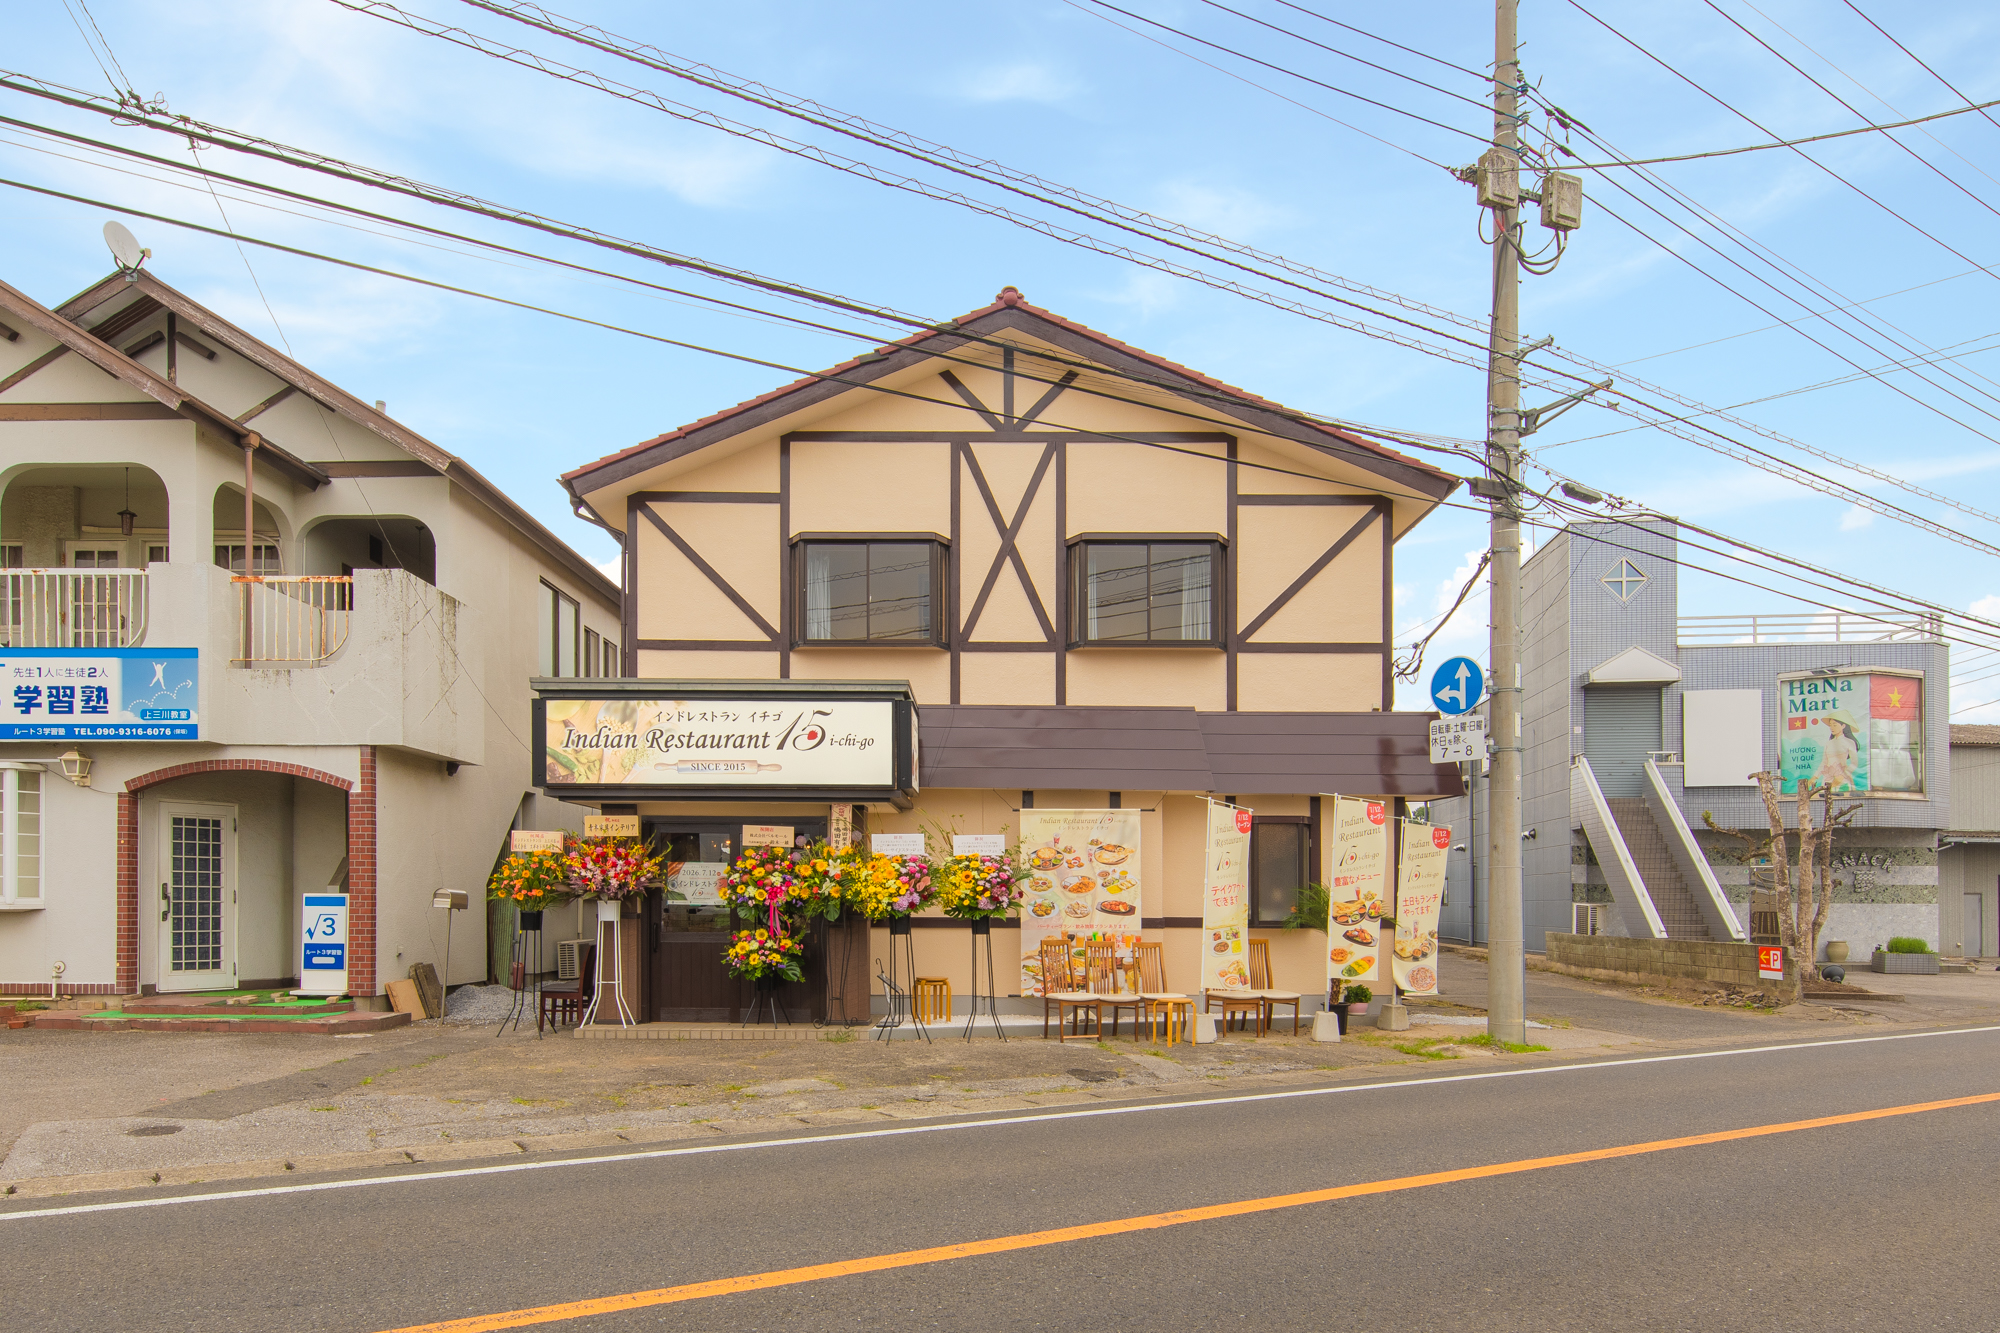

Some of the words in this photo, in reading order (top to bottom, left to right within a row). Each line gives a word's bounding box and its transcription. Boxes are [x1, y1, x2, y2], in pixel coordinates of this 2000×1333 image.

[13, 666, 109, 678] 先生1人に生徒2人
[1788, 677, 1853, 697] HaNa
[13, 684, 109, 715] 学習塾
[1788, 697, 1839, 714] Mart
[143, 710, 188, 720] 上三川教室
[654, 710, 741, 723] インドレストラン
[748, 710, 783, 723] イチゴ
[13, 727, 66, 736] ルート3学習塾
[73, 727, 172, 736] TEL.090-9316-6076
[562, 725, 638, 750] Indian
[645, 727, 771, 751] Restaurant
[776, 708, 834, 752] 15
[830, 733, 875, 750] i-chi-go
[1431, 734, 1468, 747] 休日を除く
[690, 762, 722, 771] SINCE
[723, 762, 747, 771] 2015
[1795, 762, 1812, 770] NHÀ
[1039, 816, 1061, 824] Indian
[1063, 816, 1098, 824] Restaurant
[1341, 816, 1364, 828] Indian
[1215, 824, 1234, 834] Indian
[1338, 826, 1381, 842] Restaurant
[1214, 836, 1244, 848] Restaurant
[1408, 839, 1430, 849] Indian
[1407, 850, 1441, 862] Restaurant
[1831, 852, 1893, 873] SNACK
[1334, 873, 1381, 887] 豊富なメニュー
[1211, 883, 1246, 896] テイクアウト
[1402, 893, 1439, 907] 土日もランチ
[1403, 905, 1434, 917] やってます。
[1772, 953, 1779, 967] P
